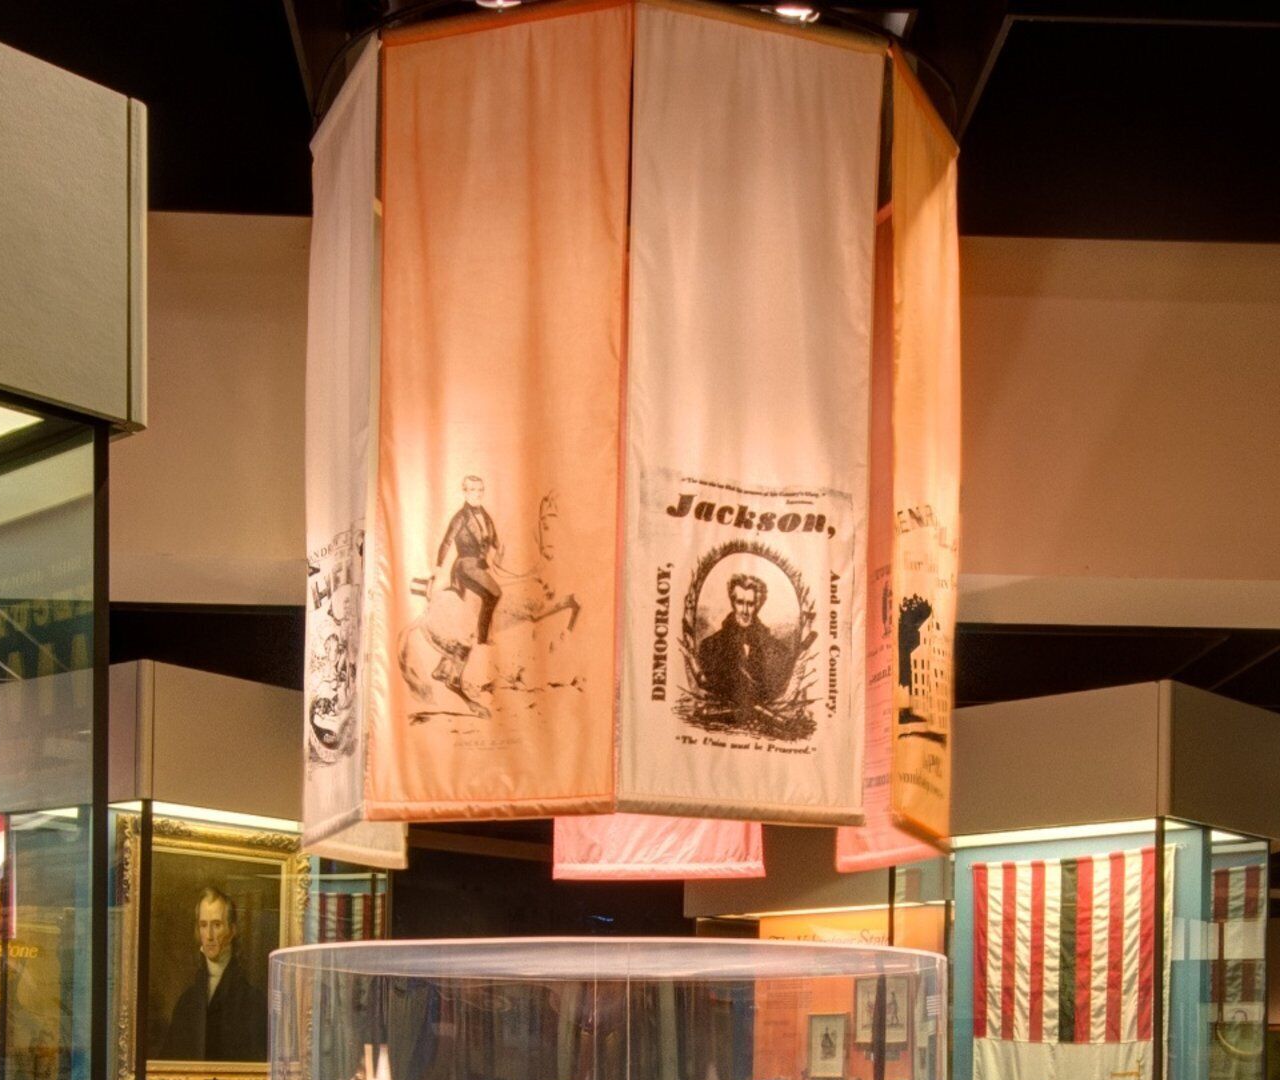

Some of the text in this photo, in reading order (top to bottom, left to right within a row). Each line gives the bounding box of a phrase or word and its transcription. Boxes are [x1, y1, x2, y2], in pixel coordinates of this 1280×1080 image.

[666, 493, 836, 539] Jackson,
[829, 570, 841, 604] And
[651, 563, 675, 701] DEMOCRACY,
[827, 610, 838, 640] our
